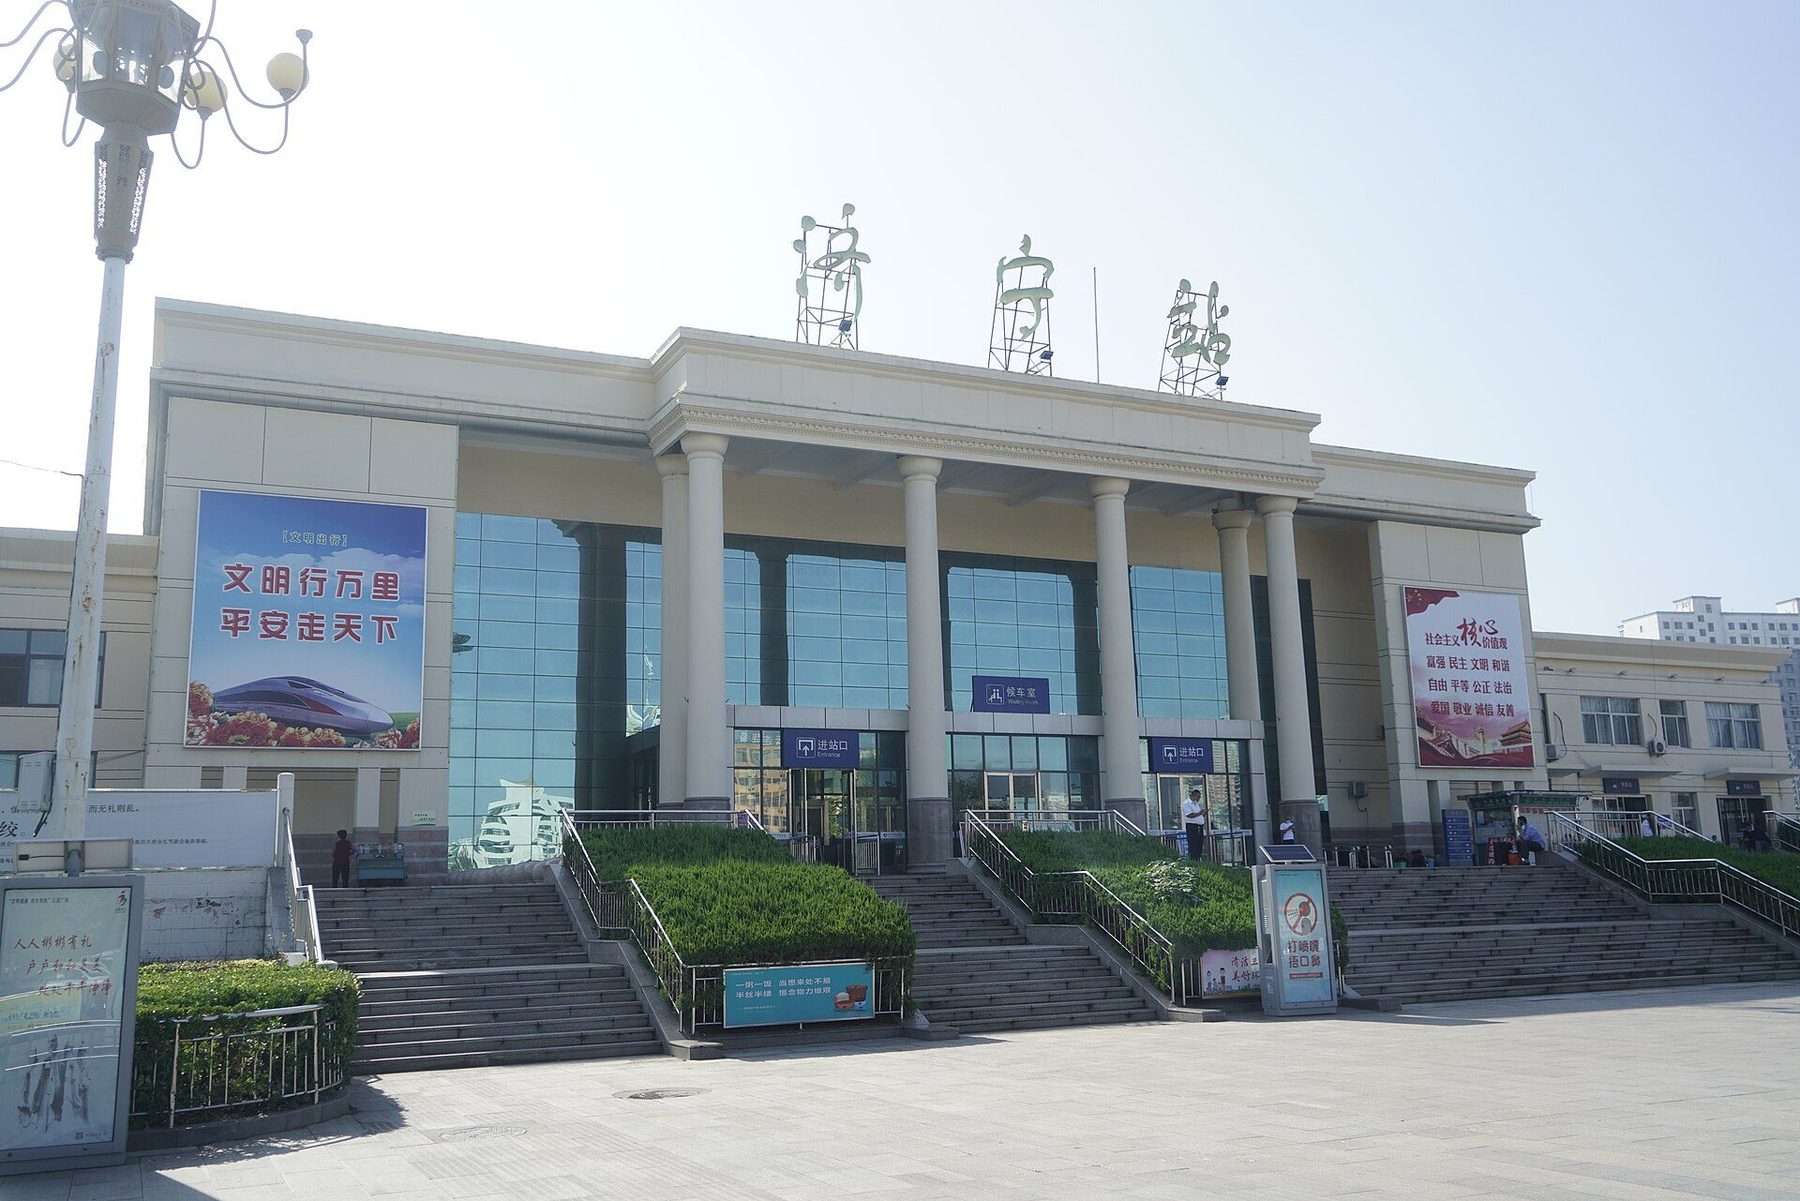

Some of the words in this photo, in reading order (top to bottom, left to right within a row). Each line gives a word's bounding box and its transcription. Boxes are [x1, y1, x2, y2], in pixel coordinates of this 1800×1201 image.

[222, 562, 401, 602] 文明行万里
[219, 607, 400, 646] 平安走天下
[1424, 617, 1508, 650] 社会主义核心价值观
[1426, 655, 1446, 669] 富强
[1449, 656, 1468, 671] 民主
[1470, 658, 1489, 671] 文明
[1492, 658, 1510, 672] 和谐
[1006, 686, 1036, 698] 候车室
[1428, 678, 1447, 692] 自由
[1451, 679, 1469, 693] 平等
[1472, 680, 1491, 694] 公正
[1494, 681, 1512, 694] 法治
[1431, 701, 1450, 715] 爱国
[1453, 702, 1472, 716] 敬业
[1475, 702, 1493, 717] 诚信
[1496, 703, 1515, 718] 友善
[817, 739, 848, 751] 进站口
[1179, 747, 1204, 757] 进站口
[14, 934, 92, 950] 人人彬彬有礼
[1287, 939, 1320, 953] 打喷嚏
[1288, 955, 1322, 969] 捂口鼻
